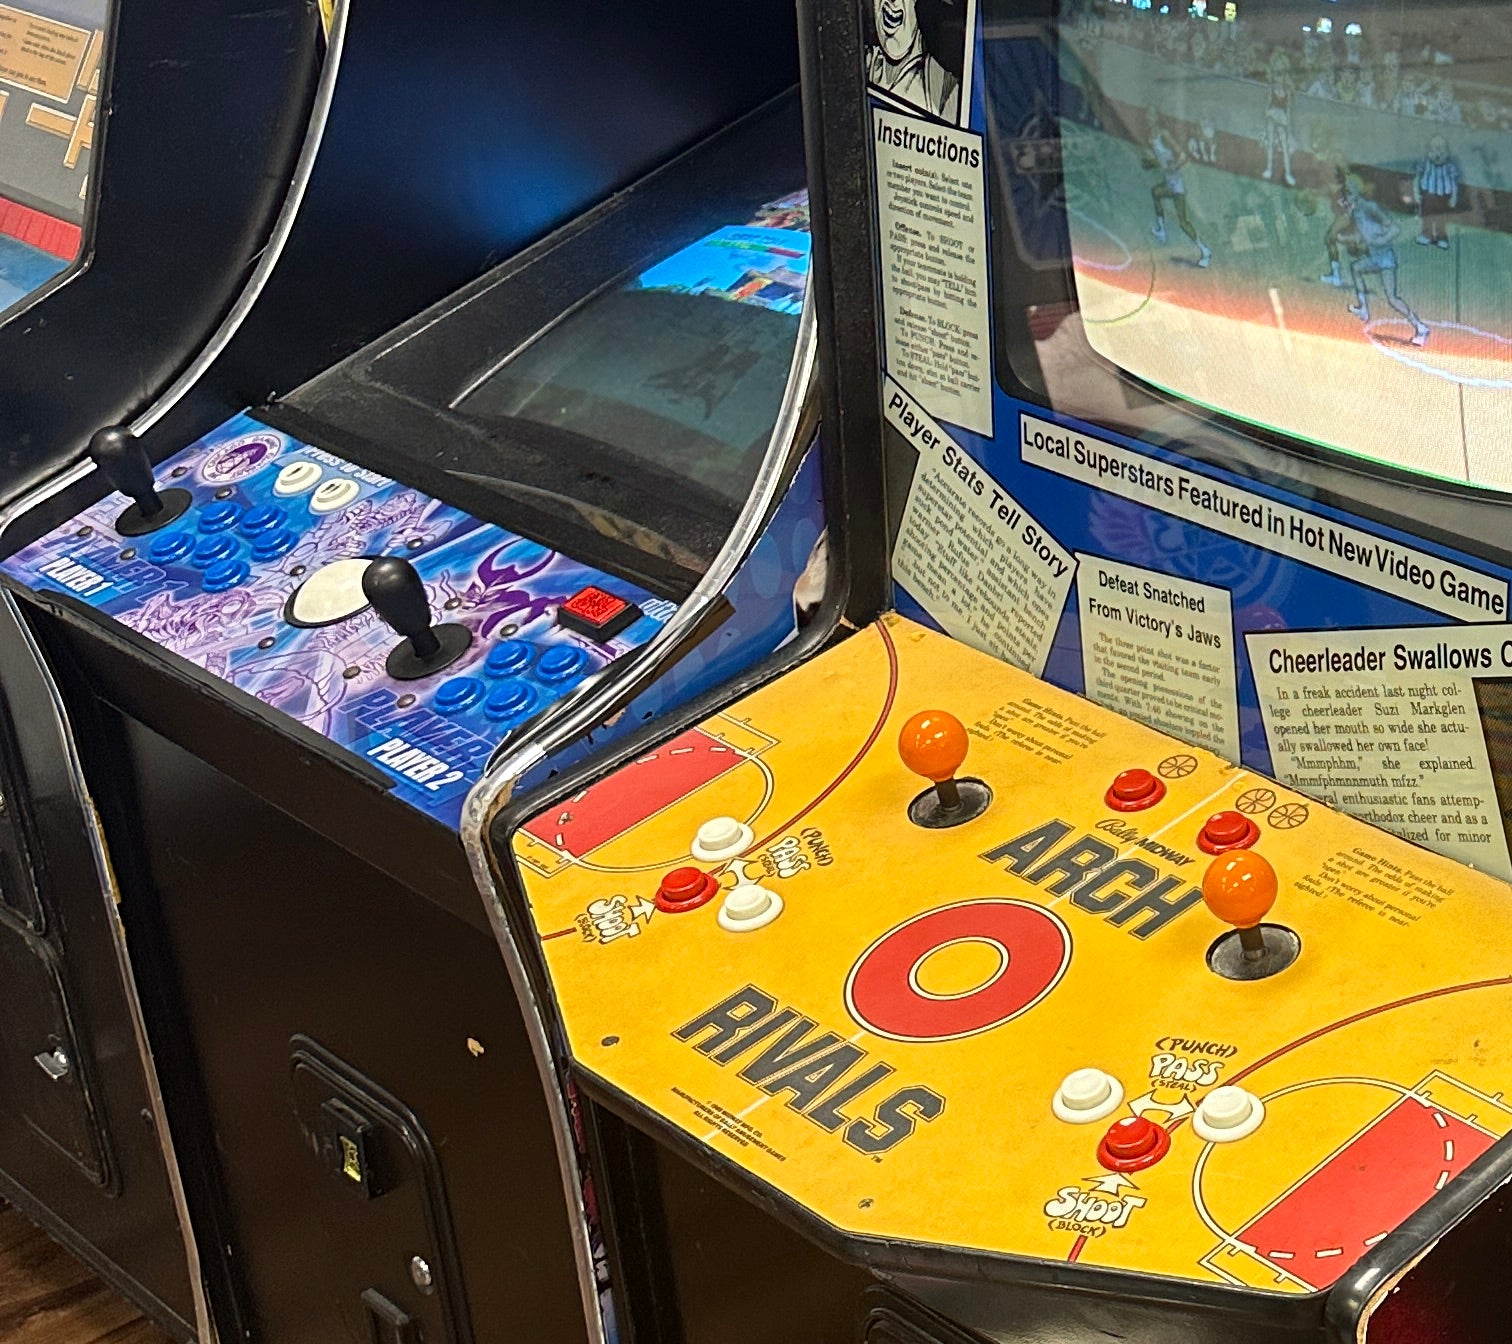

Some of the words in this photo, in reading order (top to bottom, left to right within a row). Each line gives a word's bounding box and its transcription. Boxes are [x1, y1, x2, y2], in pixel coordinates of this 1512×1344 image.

[877, 117, 981, 169] Instructions
[888, 392, 942, 452] Player
[941, 443, 985, 497] Stats
[989, 488, 1020, 531] Tell
[1020, 523, 1070, 579] Story
[1023, 421, 1071, 461] Local
[1073, 441, 1176, 498] Superstars
[1178, 476, 1264, 530] Featured
[1267, 508, 1286, 537] in
[1289, 516, 1327, 552] Hot
[1328, 528, 1376, 569] New
[1376, 549, 1437, 592] Video
[1438, 571, 1505, 617] Game
[39, 555, 105, 594] PLAYER
[83, 580, 115, 597] 1
[1098, 570, 1141, 599] Defeat
[1143, 582, 1206, 615] Snatched
[1088, 596, 1122, 623] From
[1125, 606, 1184, 641] Victory's
[1186, 623, 1223, 650] Jaws
[1269, 646, 1386, 675] Cheerleader
[1393, 643, 1494, 670] Swallows
[1269, 704, 1291, 720] lege
[1301, 703, 1363, 717] cheerleader
[1374, 702, 1400, 716] Suzi
[1410, 701, 1466, 717] Markglen
[1276, 687, 1288, 700] In
[1292, 691, 1300, 700] a
[1303, 686, 1331, 700] freak
[1335, 685, 1380, 698] accident
[1382, 684, 1405, 698] last
[1408, 683, 1438, 698] night
[1441, 682, 1462, 696] col-
[1274, 721, 1310, 737] opened
[1312, 721, 1331, 734] her
[1335, 721, 1369, 734] mouth
[1372, 724, 1385, 734] so
[1388, 720, 1415, 734] wide
[1418, 720, 1437, 734] she
[1440, 719, 1470, 733] actu-
[1277, 739, 1296, 754] ally
[1300, 738, 1353, 752] swallowed
[1356, 738, 1375, 751] her
[1378, 741, 1401, 751] own
[1404, 738, 1429, 751] face!
[366, 737, 450, 784] PLAYER
[424, 770, 464, 792] 2
[1381, 755, 1401, 769] she
[1342, 790, 1408, 806] enthusiastic
[1411, 791, 1437, 806] fans
[1440, 790, 1486, 808] attemp-
[1407, 809, 1438, 824] cheer
[1441, 809, 1463, 824] and
[1465, 813, 1479, 824] as
[1481, 814, 1489, 824] a
[800, 826, 835, 868] (PUNCH)
[1095, 818, 1139, 845] Bally
[1134, 836, 1197, 868] MIDWAY
[1434, 827, 1451, 842] for
[1457, 830, 1492, 843] minor
[765, 834, 812, 879] PASS
[977, 818, 1204, 942] ARCH
[586, 893, 642, 946] SHOOT
[1155, 1036, 1239, 1059] (PUNCH)
[671, 982, 947, 1156] RIVALS
[1149, 1052, 1226, 1087] PASS
[1150, 1078, 1198, 1093] (STEAL)
[1043, 1185, 1149, 1229] SHOOT
[1047, 1218, 1107, 1239] (BLOCK)
